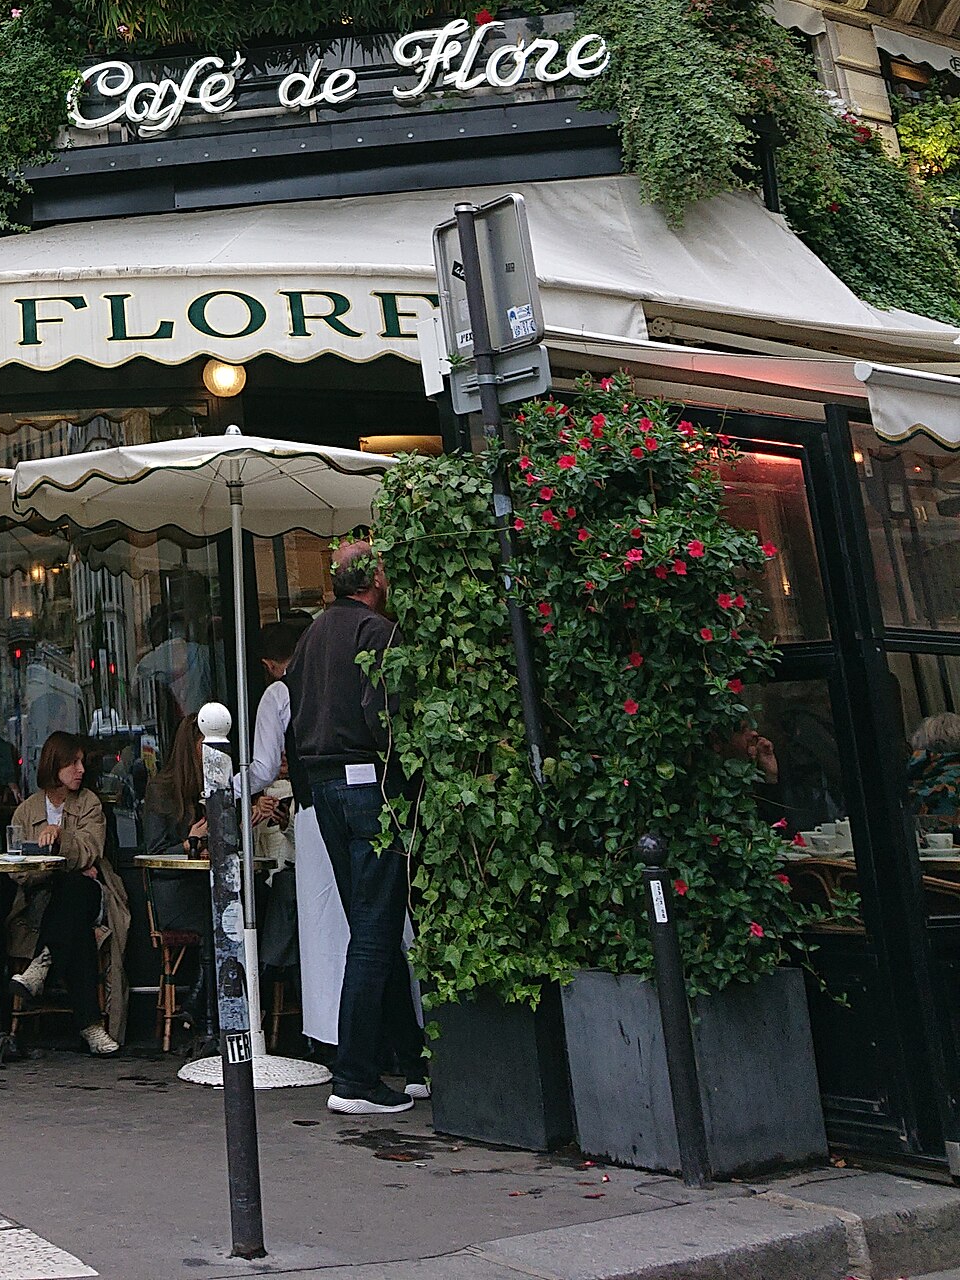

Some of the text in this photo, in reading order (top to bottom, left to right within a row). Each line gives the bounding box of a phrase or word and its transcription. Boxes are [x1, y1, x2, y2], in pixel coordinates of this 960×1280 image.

[66, 18, 611, 139] Café de Flore
[14, 287, 440, 346] FLORE
[227, 1034, 252, 1062] TER
